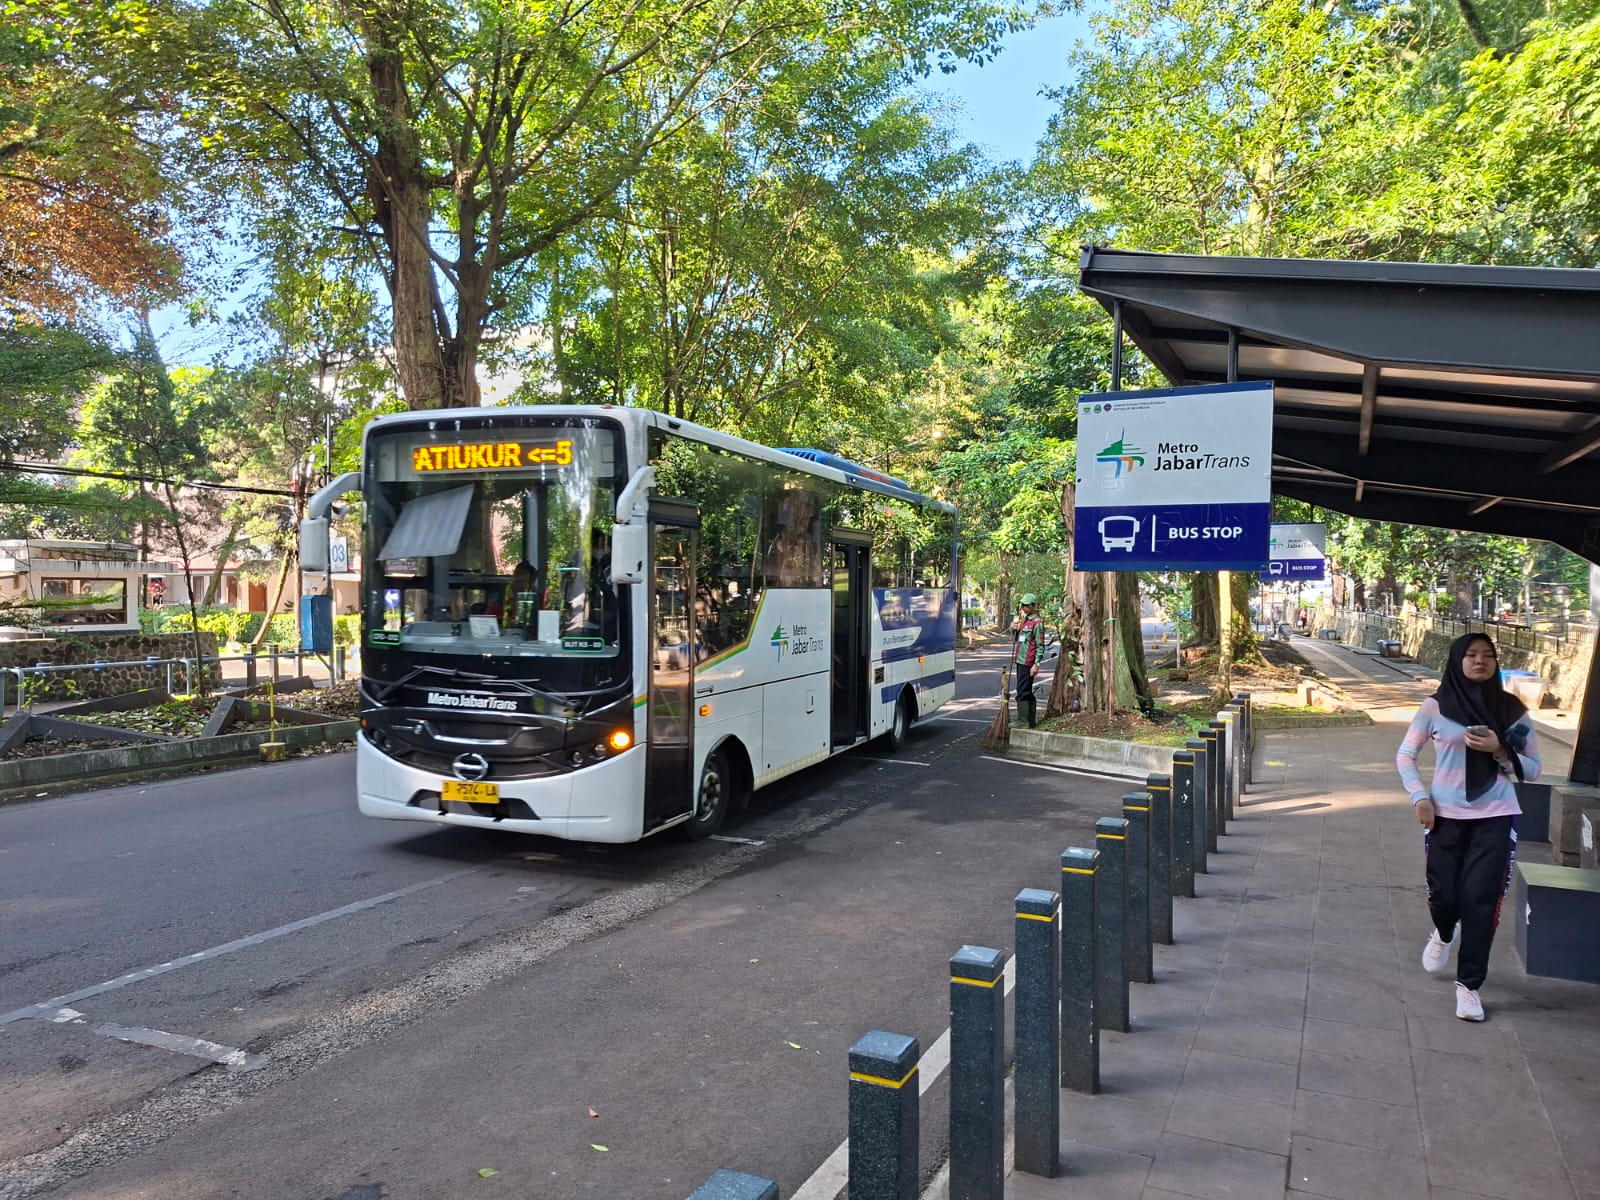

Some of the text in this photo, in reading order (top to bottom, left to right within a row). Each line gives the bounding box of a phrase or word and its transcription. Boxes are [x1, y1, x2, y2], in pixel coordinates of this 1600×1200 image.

[413, 442, 523, 471] ATIUKUR
[1158, 443, 1199, 454] Metro
[1153, 453, 1250, 471] JabarTrans
[1168, 526, 1243, 539] BUS STOP
[331, 543, 346, 563] 03
[792, 623, 808, 637] Metro
[791, 637, 824, 656] JabarTrans
